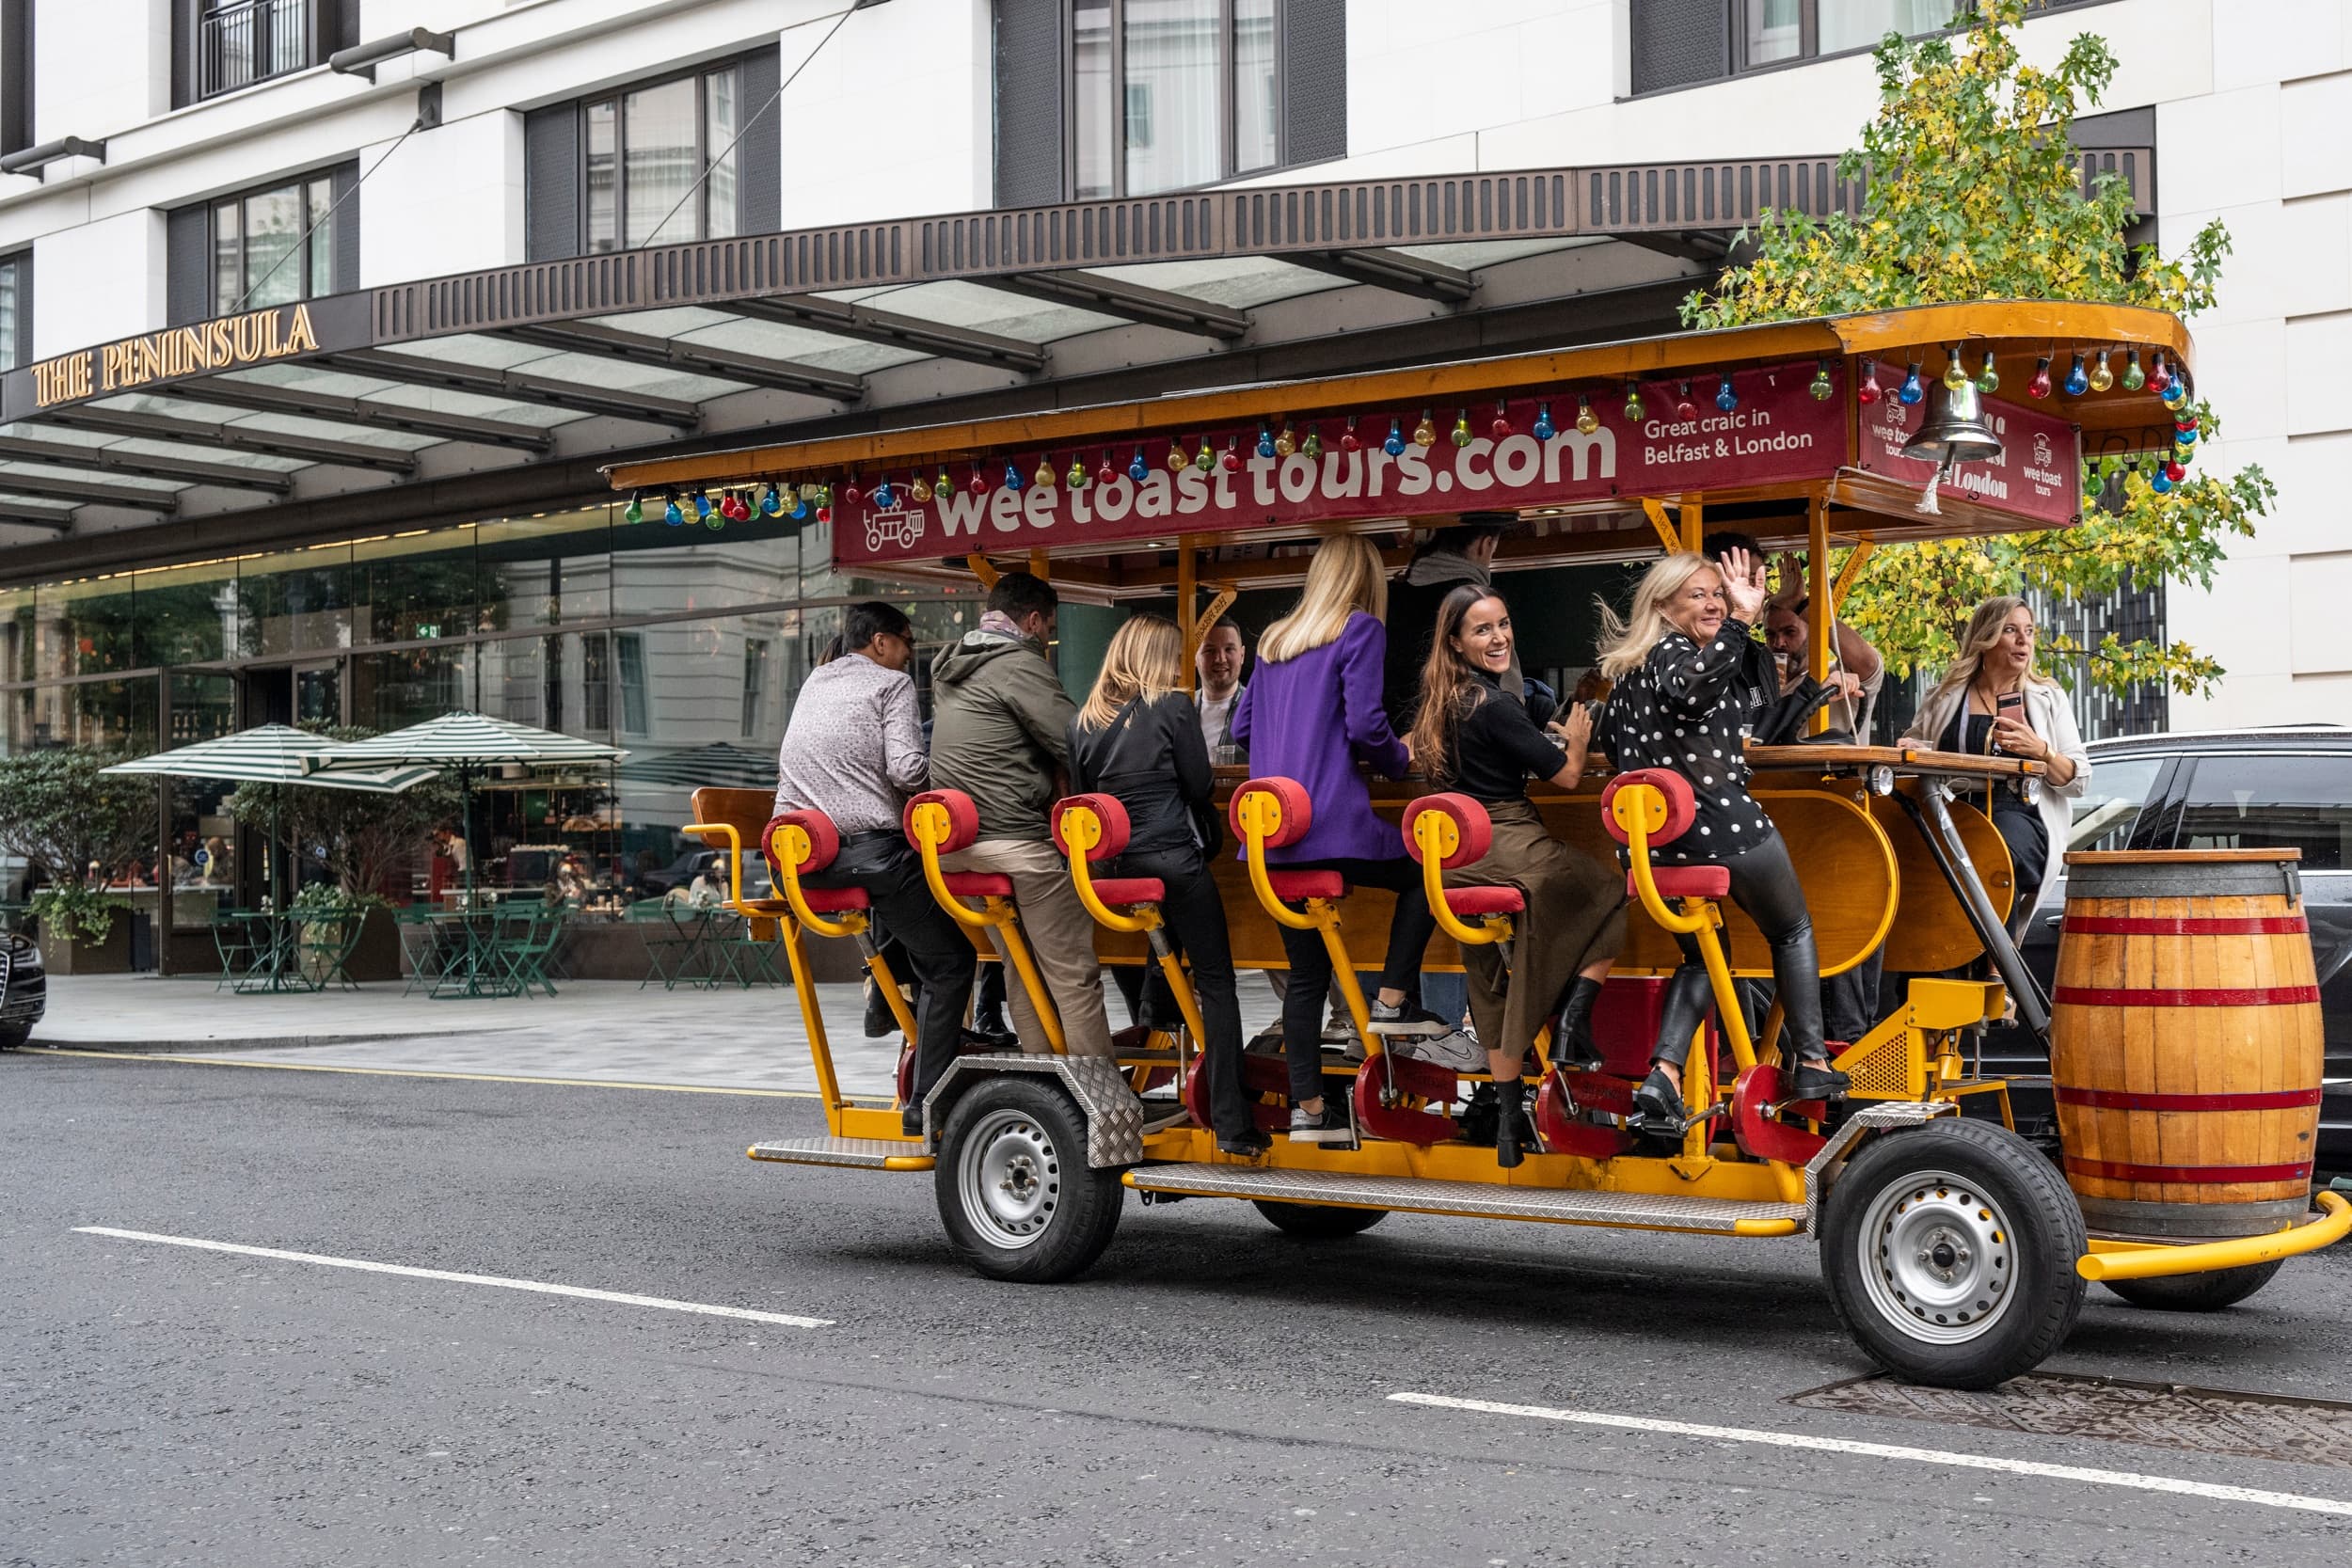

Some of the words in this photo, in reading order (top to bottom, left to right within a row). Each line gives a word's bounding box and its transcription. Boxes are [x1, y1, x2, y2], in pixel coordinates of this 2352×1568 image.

[31, 352, 93, 407] THE
[101, 303, 321, 391] PENINSULA
[1645, 419, 1697, 439] Great
[1700, 411, 1746, 434] craic
[1752, 408, 1771, 427] in
[1871, 423, 1895, 442] wee
[1645, 443, 1710, 466] Belfast
[1715, 437, 1730, 458] &
[1735, 431, 1813, 455] London
[1884, 442, 1905, 459] tour
[1954, 463, 2008, 500] London
[2024, 465, 2042, 482] wee
[2041, 469, 2062, 488] toast
[2035, 483, 2051, 497] tours
